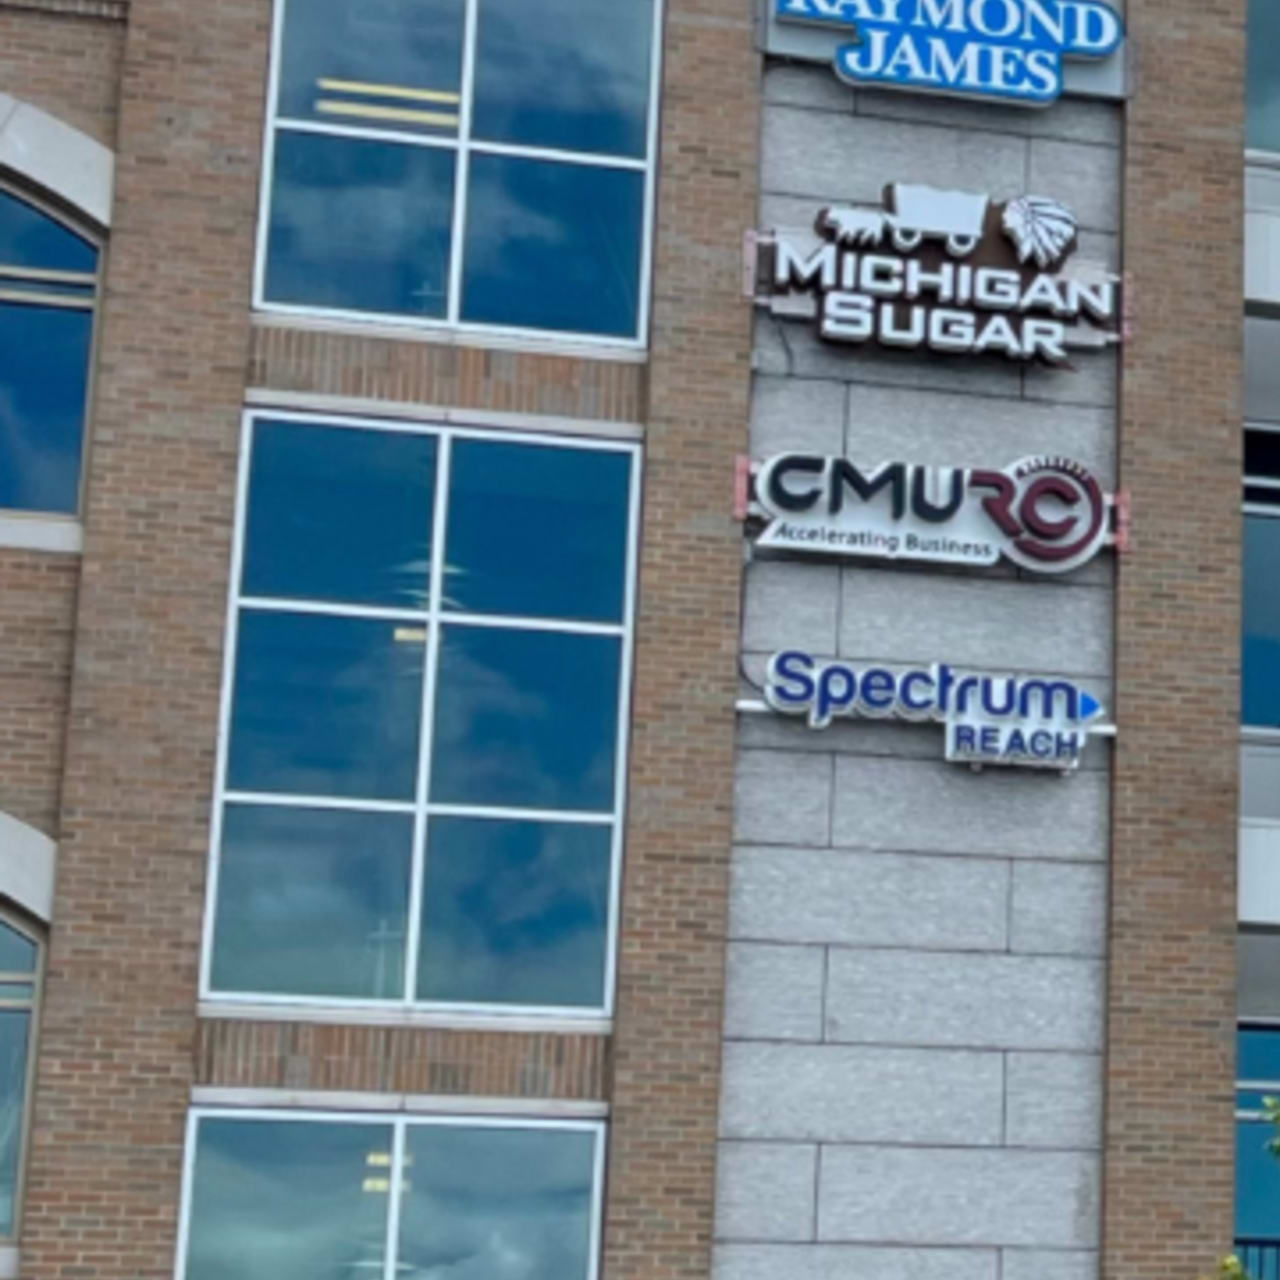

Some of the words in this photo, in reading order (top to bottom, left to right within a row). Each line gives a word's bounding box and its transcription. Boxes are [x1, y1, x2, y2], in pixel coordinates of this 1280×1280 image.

[845, 29, 1059, 96] JAMES
[773, 523, 901, 554] Accelerating
[905, 533, 994, 558] Business
[773, 651, 1079, 720] Spectrum
[954, 725, 1079, 759] REACH
